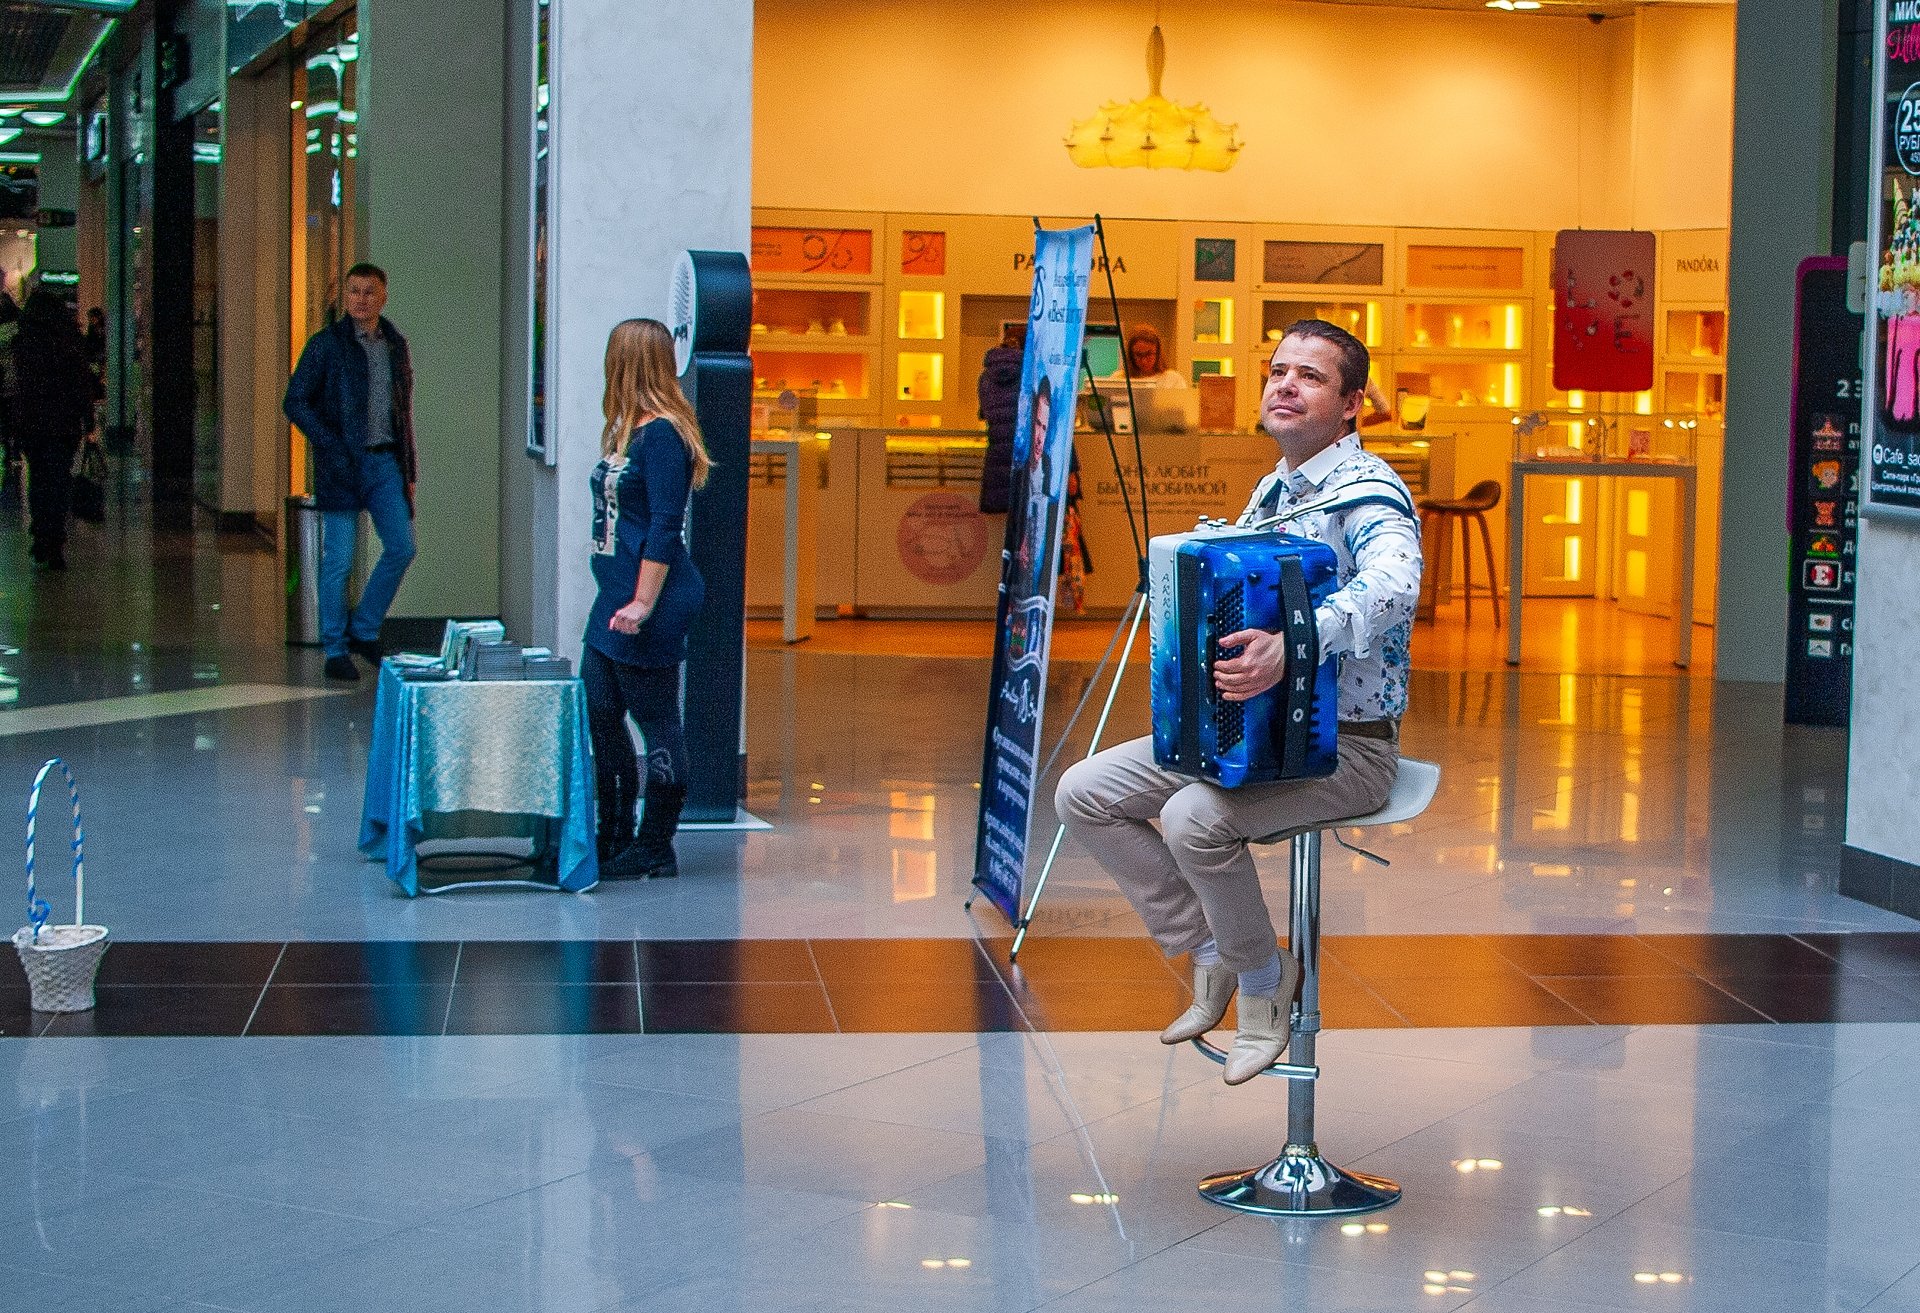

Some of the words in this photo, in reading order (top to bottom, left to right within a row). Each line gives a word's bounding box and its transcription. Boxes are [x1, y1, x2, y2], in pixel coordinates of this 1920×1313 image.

[1013, 253, 1126, 273] PARA
[1161, 573, 1171, 620] AKKO
[1293, 609, 1308, 723] AKKO
